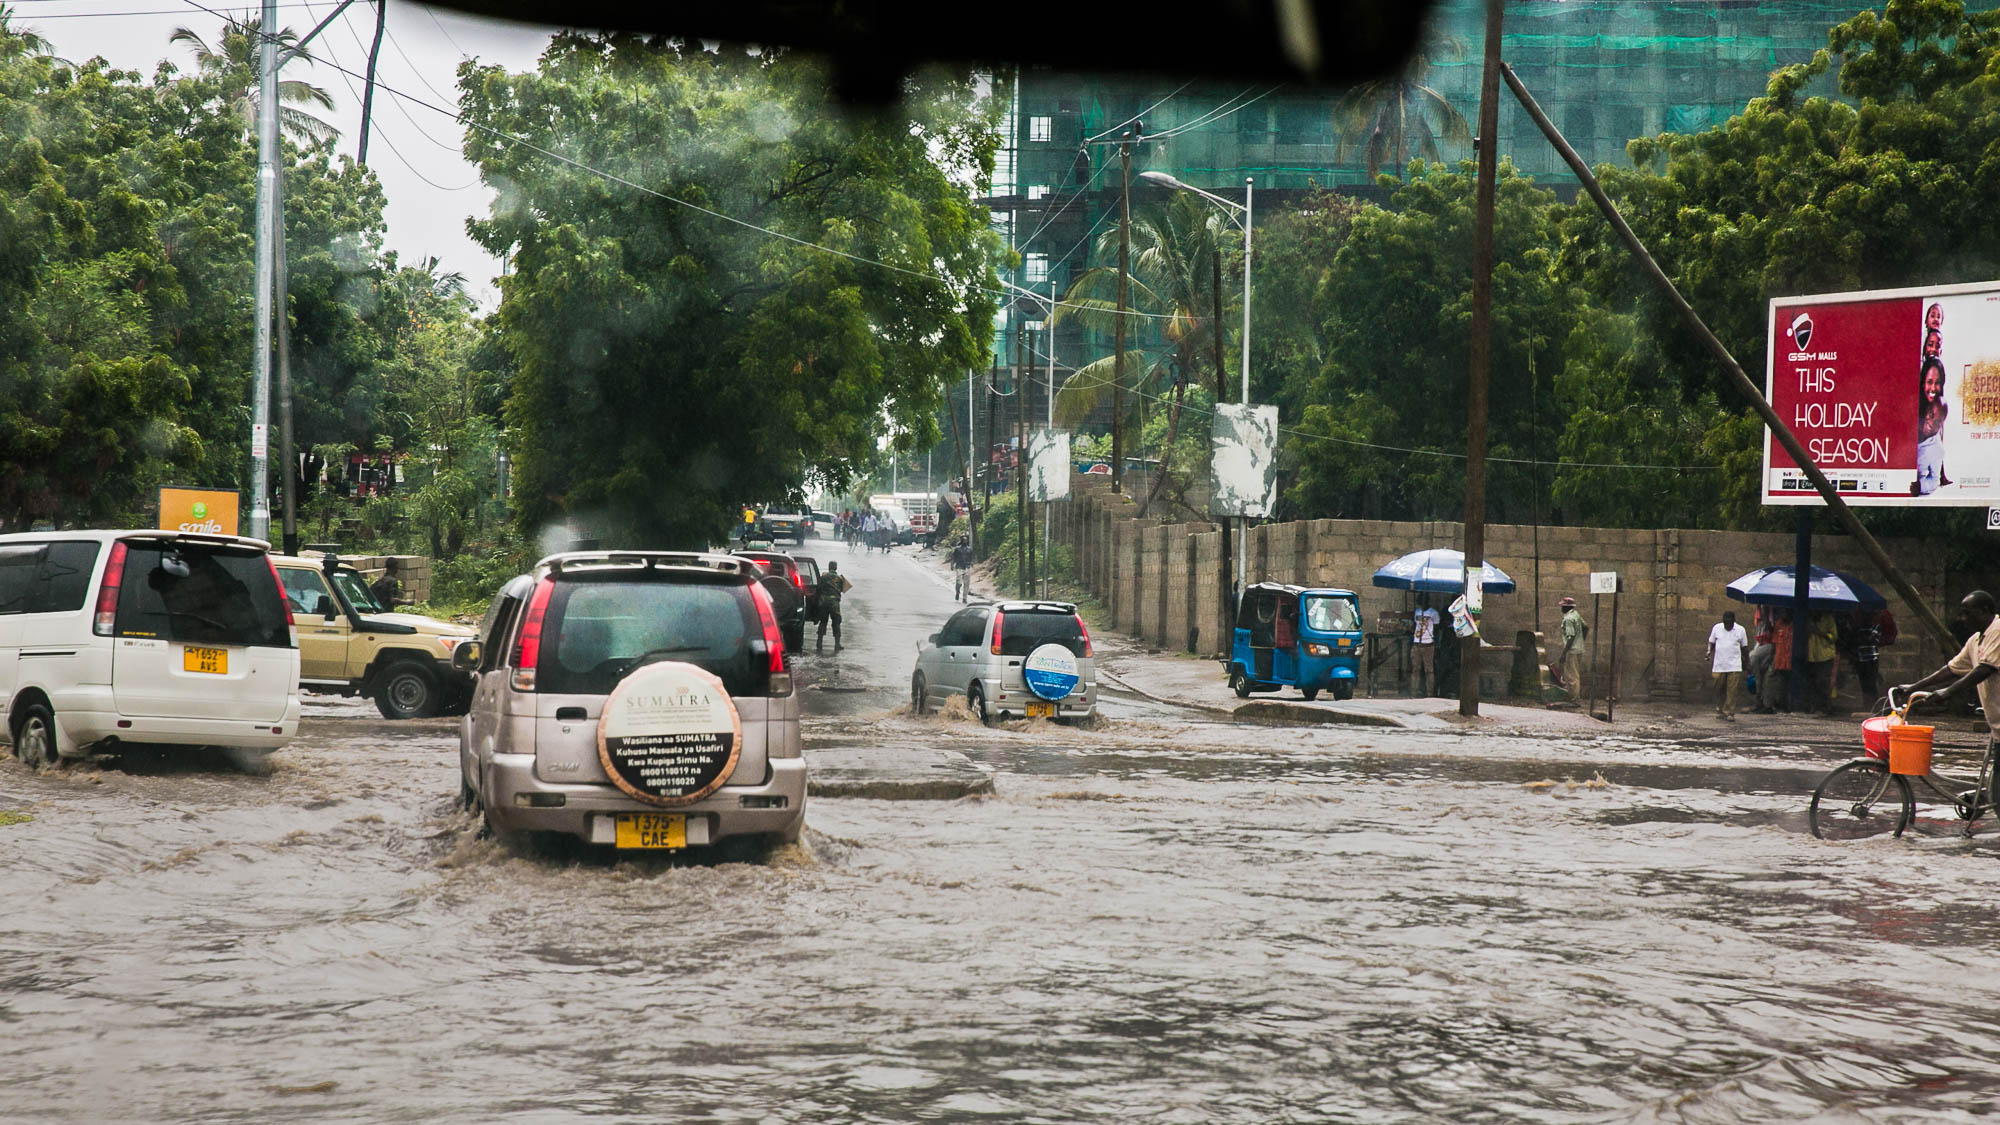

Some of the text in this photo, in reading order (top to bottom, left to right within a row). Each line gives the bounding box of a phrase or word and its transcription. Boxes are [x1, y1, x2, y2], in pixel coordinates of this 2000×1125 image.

[1788, 352, 1837, 361] GSM MALLS
[1795, 368, 1835, 392] THIS
[1795, 402, 1877, 428] HOLIDAY
[1809, 437, 1889, 463] SEASON
[178, 519, 222, 534] smile
[626, 694, 710, 707] SUMATRA
[622, 737, 662, 745] Wasiliana
[675, 734, 716, 743] SUMATRA
[616, 748, 648, 756] Kuhusu
[696, 744, 724, 752] Usafiri
[647, 758, 675, 766] Kupiga
[676, 756, 697, 764] Simu
[699, 755, 713, 763] Na.
[641, 831, 669, 846] CAE
